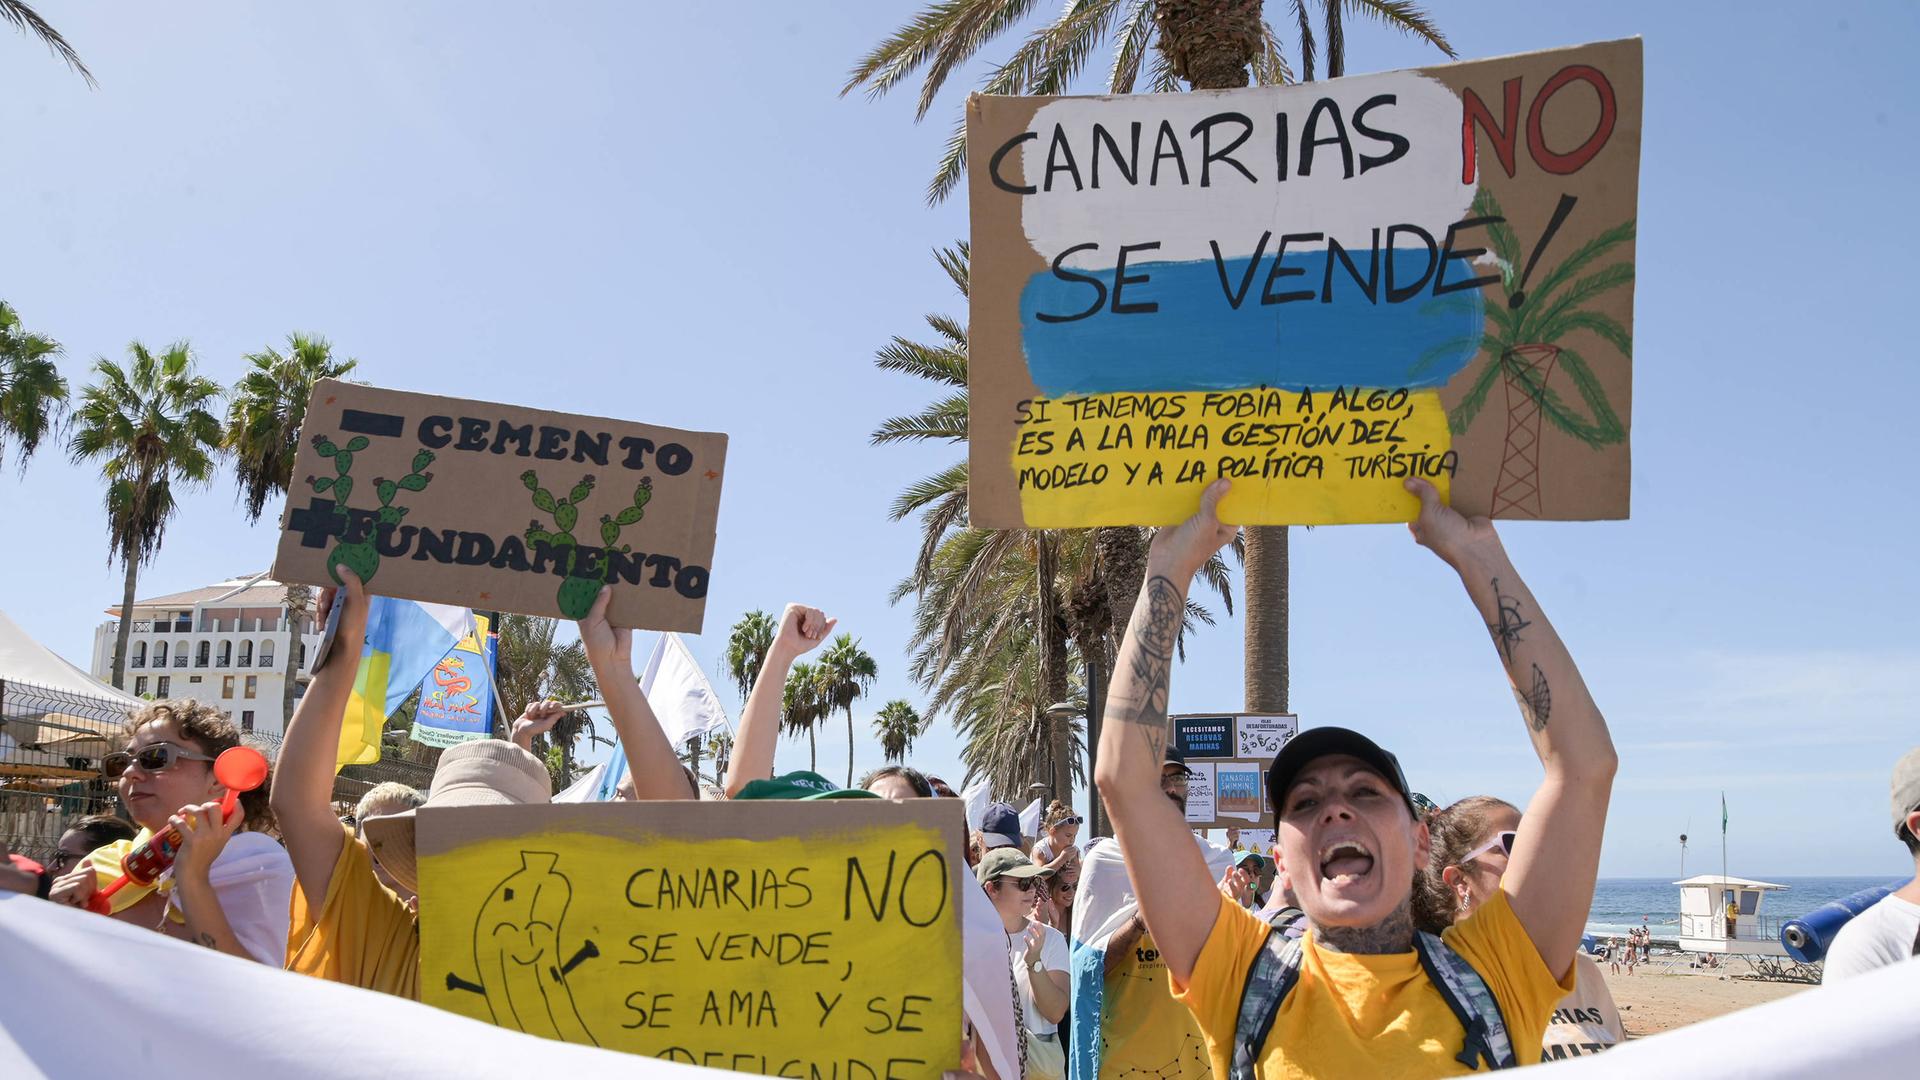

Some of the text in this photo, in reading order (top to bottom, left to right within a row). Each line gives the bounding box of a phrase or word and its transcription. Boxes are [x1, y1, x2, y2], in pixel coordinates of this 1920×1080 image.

[989, 65, 1617, 195] CANARIAS NO
[1036, 241, 1161, 324] SE
[1014, 399, 1047, 425] SI
[1068, 394, 1187, 422] TENEMOS
[1327, 386, 1415, 420] ALGO,
[417, 415, 694, 476] CEMENTO
[1018, 427, 1055, 456] ES
[1066, 425, 1086, 451] A
[1102, 423, 1134, 452] LA
[1146, 422, 1209, 451] MALA
[1348, 418, 1408, 446] DEL
[1019, 461, 1109, 491] MODELO
[1124, 463, 1142, 486] Y
[1147, 460, 1164, 485] A
[1175, 458, 1206, 485] LA
[1182, 725, 1226, 733] NECESITAMOS
[1186, 734, 1223, 742] RESERVAS
[1189, 743, 1221, 751] MARINAS
[1220, 774, 1255, 782] CANARIAS
[1221, 782, 1255, 791] SWIMMING
[625, 848, 949, 928] CANARIAS NO
[618, 931, 854, 982] SE VENDE,
[621, 990, 933, 1034] SE AMA Y SE
